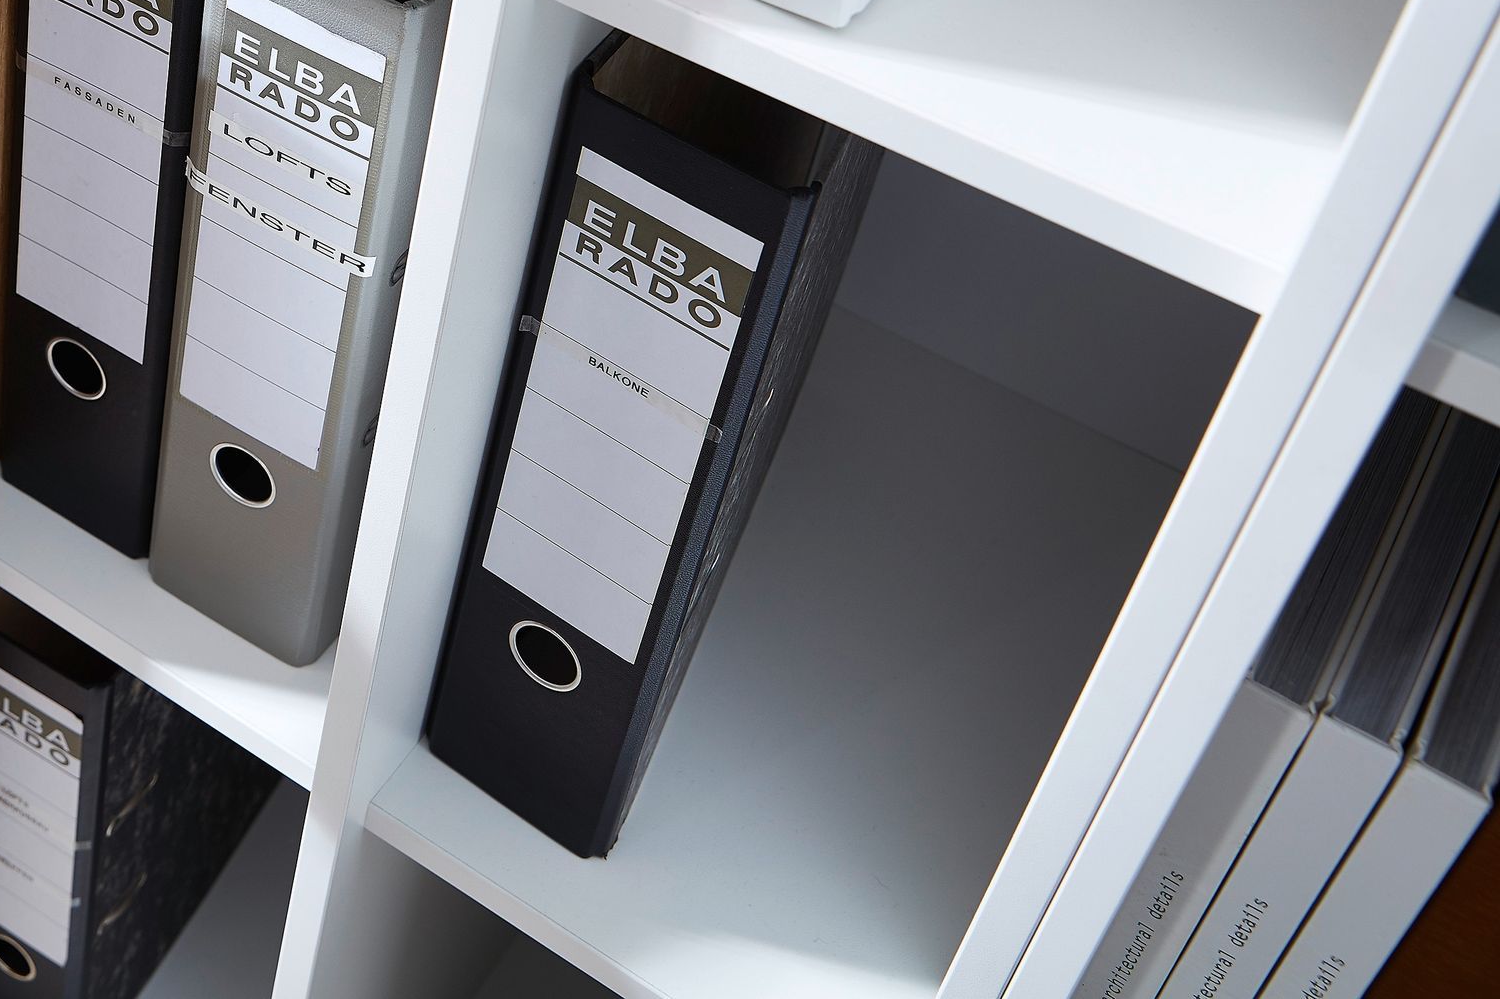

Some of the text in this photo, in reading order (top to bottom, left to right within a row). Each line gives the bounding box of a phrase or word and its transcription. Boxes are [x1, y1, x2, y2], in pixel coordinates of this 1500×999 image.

[54, 76, 136, 124] FASSADEN
[230, 63, 361, 143] RADO
[233, 29, 362, 116] ELBA
[223, 122, 352, 196] LOFTS
[187, 171, 368, 274] FENSTER
[582, 199, 726, 304] ELBA
[575, 232, 722, 329] RADO
[588, 356, 650, 398] BALKONE
[1147, 870, 1184, 920] details
[1193, 897, 1269, 999] tectural details
